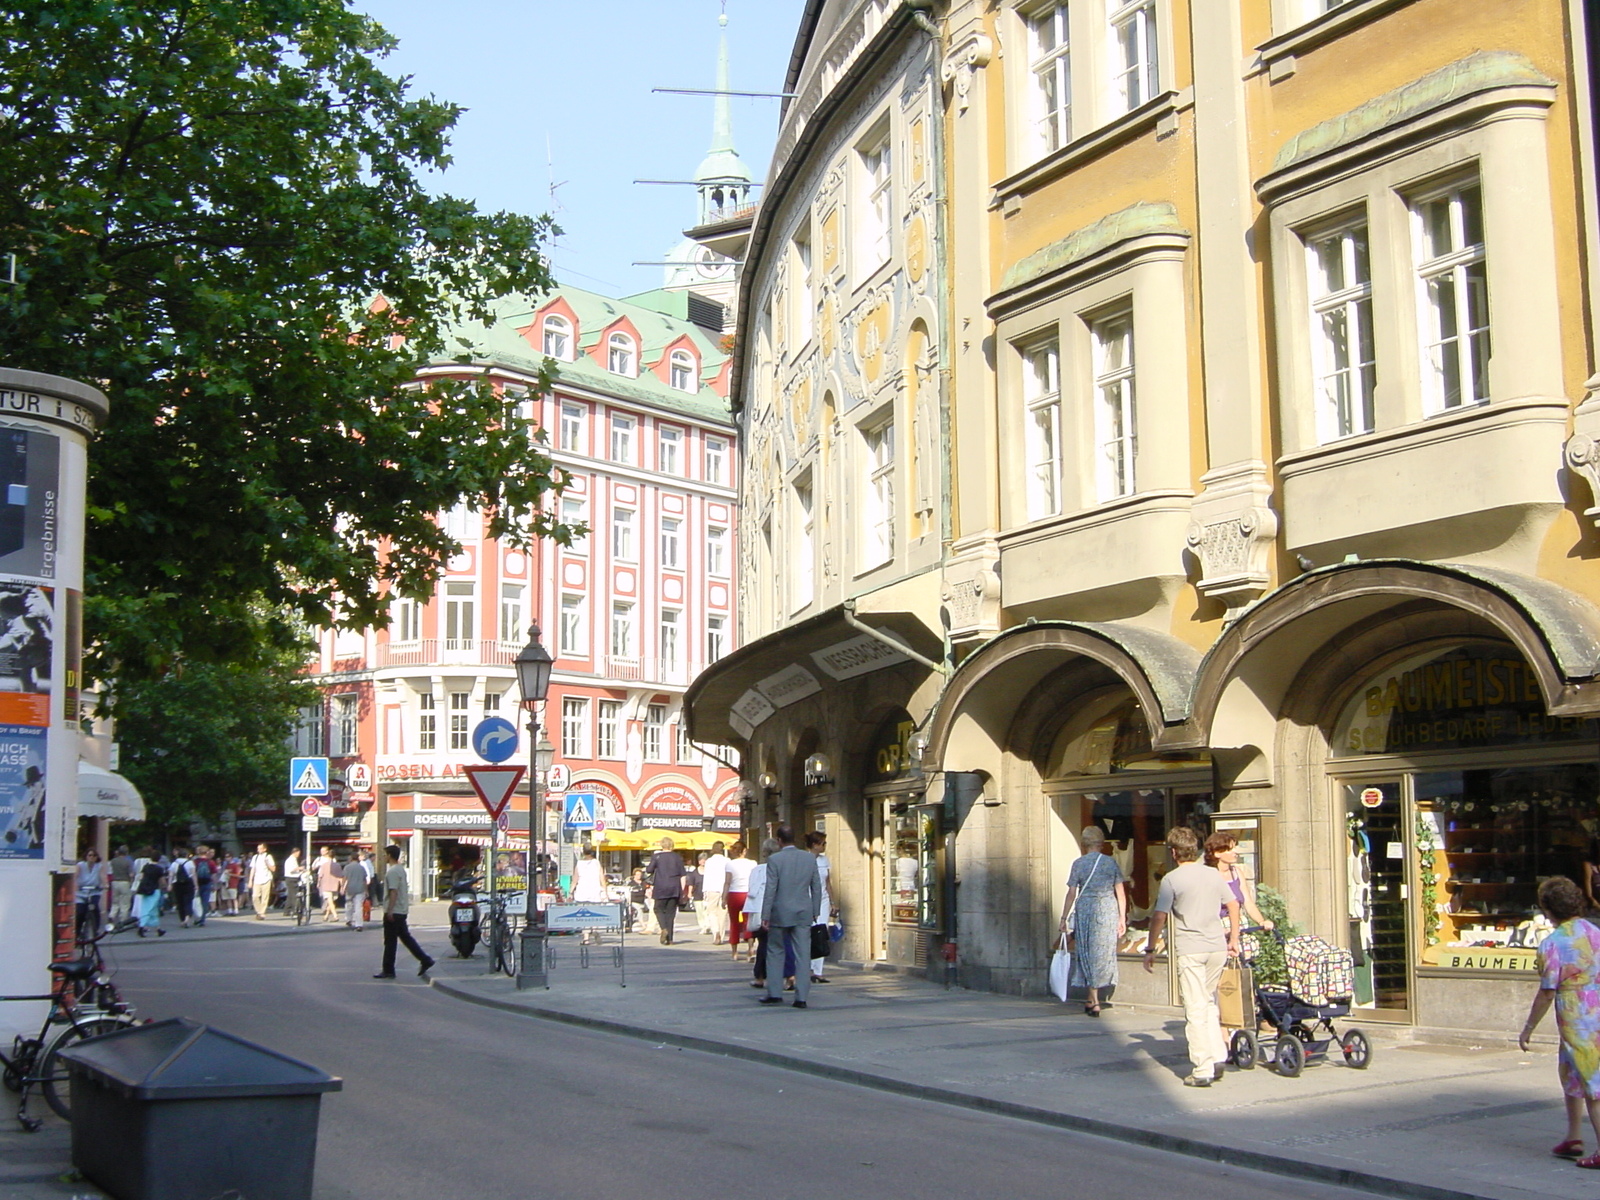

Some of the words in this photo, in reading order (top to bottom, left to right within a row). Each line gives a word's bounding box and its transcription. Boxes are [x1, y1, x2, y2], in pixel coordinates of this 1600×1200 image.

[41, 490, 55, 578] Ergebnisse
[1349, 715, 1504, 751] SCHUHBEDARF
[377, 764, 434, 778] ROSEN
[653, 801, 693, 812] PHARMACIE
[727, 804, 740, 813] PHA
[414, 814, 492, 825] ROSENAPOTHE
[642, 818, 703, 828] ROSENAPOTHEKE
[1451, 956, 1542, 971] BAUMEIS
